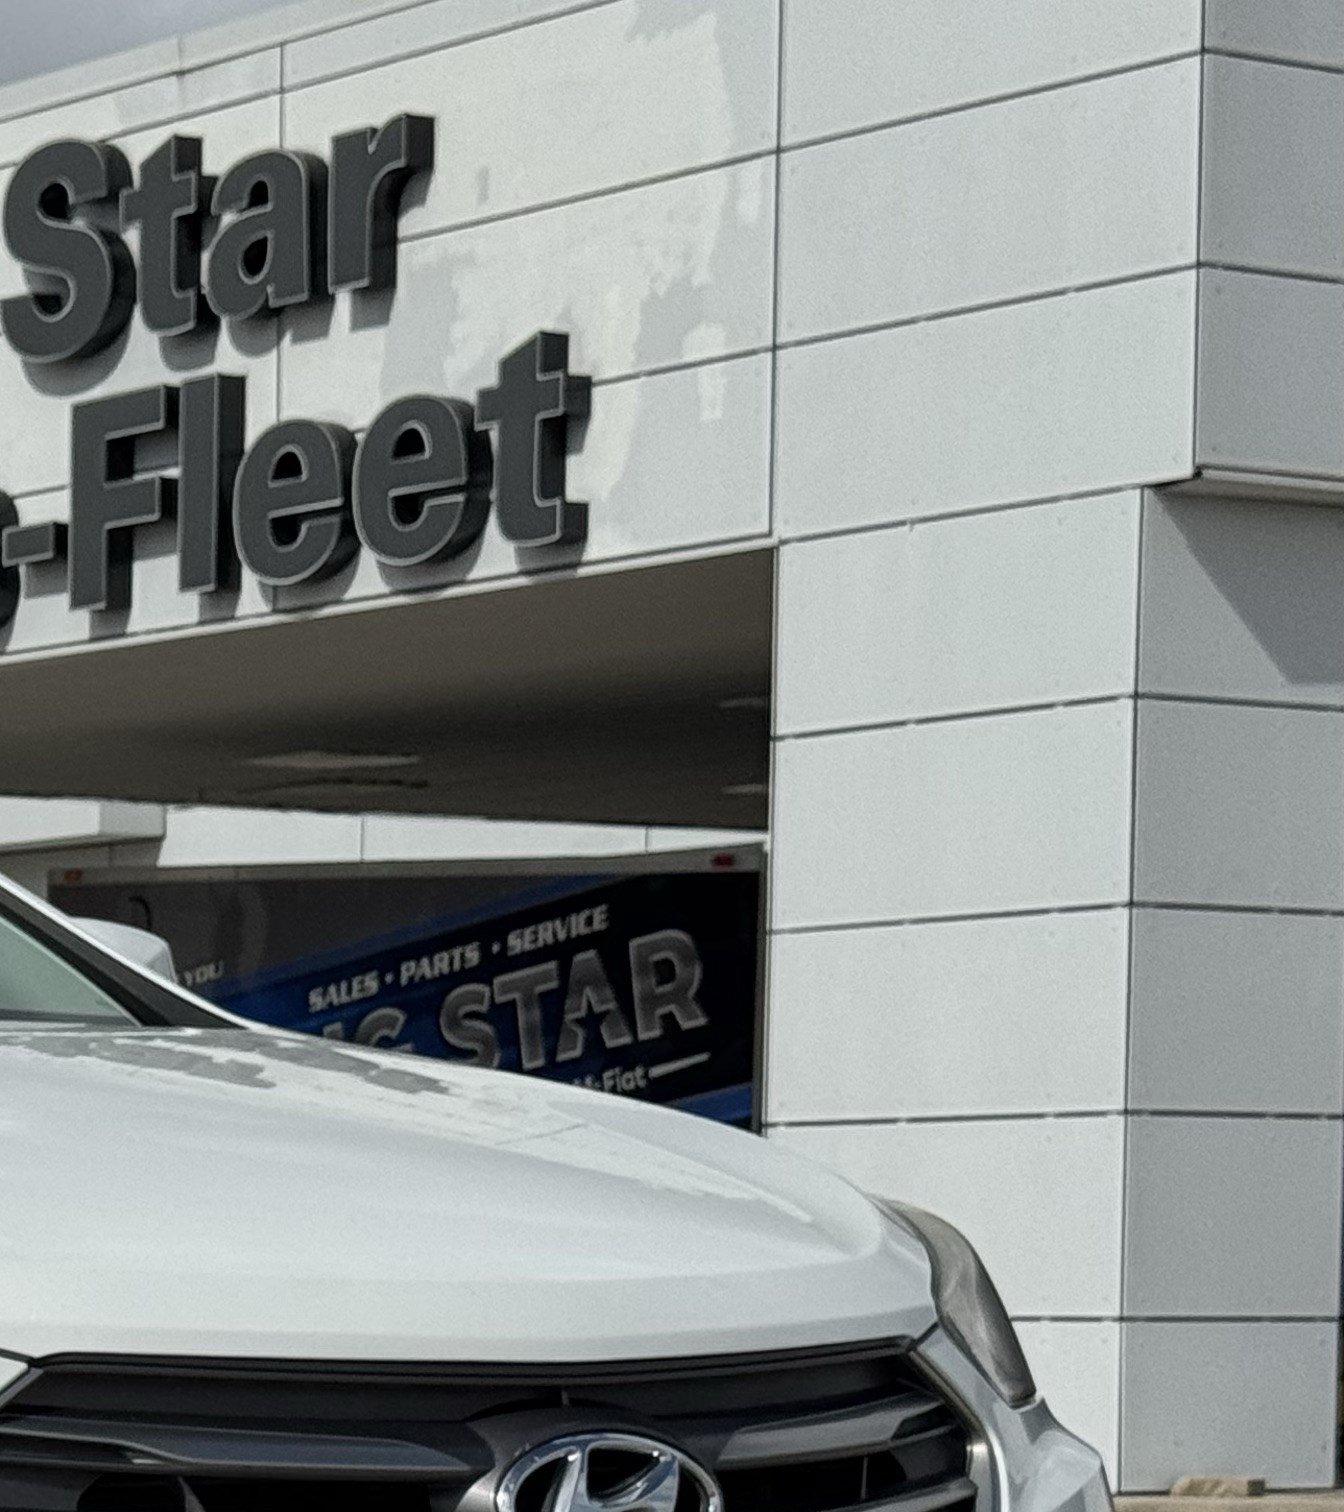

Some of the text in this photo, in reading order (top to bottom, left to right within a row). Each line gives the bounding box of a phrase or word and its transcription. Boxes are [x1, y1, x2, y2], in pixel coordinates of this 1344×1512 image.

[0, 114, 436, 366] Star
[309, 904, 609, 1012] SALES PARTS SERVICE
[439, 928, 710, 1072] STAR
[601, 1065, 647, 1093] Fiat
